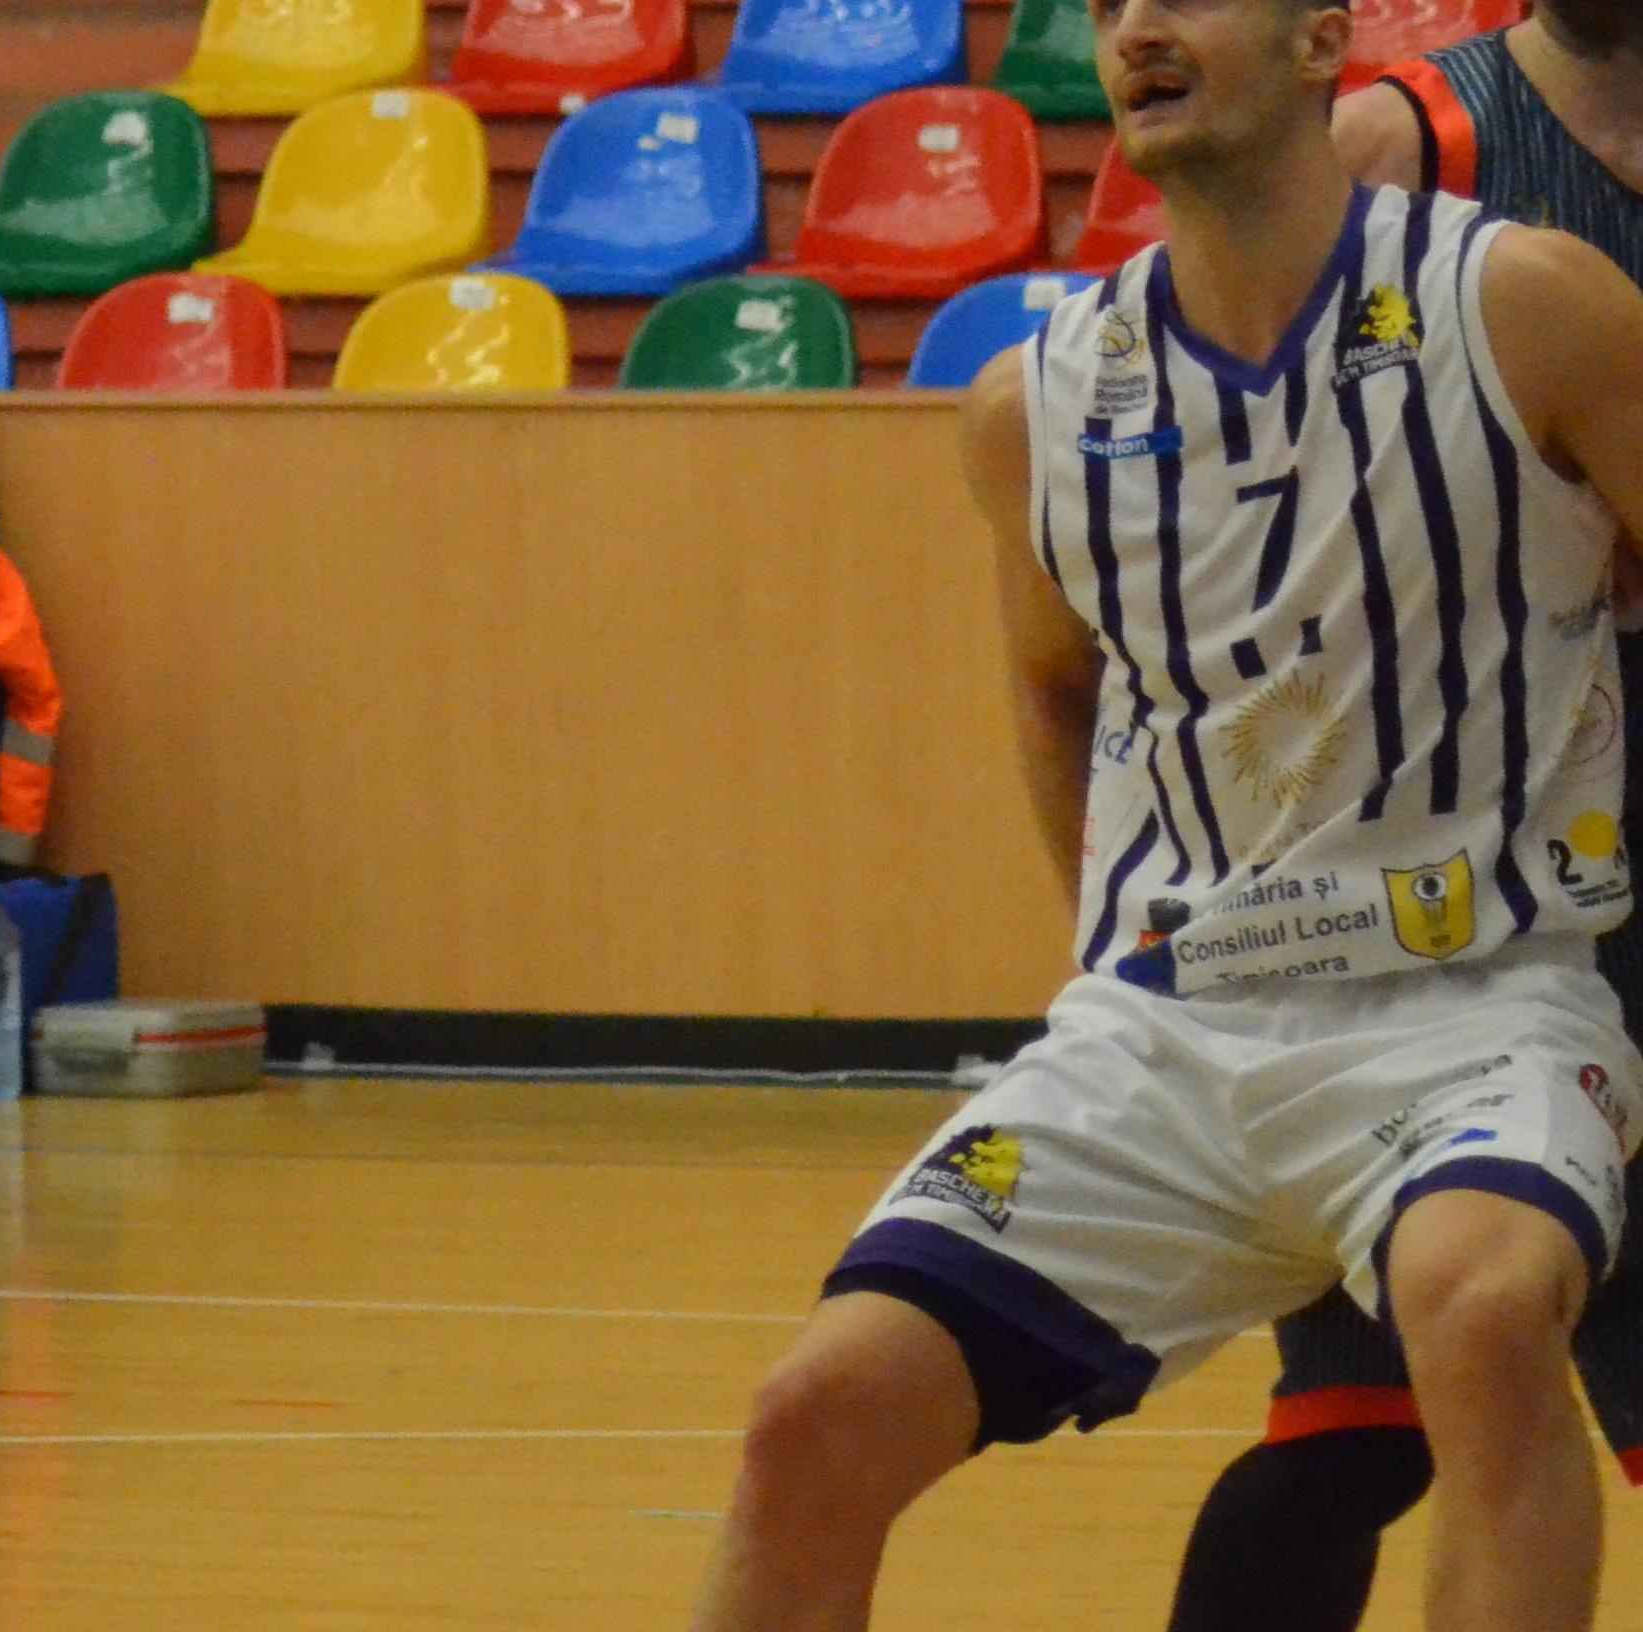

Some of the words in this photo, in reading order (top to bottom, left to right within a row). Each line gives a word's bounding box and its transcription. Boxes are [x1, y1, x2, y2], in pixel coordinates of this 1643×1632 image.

[1078, 437, 1149, 458] cotton
[1234, 464, 1300, 613] 7
[1176, 919, 1287, 965] Consiliul
[1294, 902, 1380, 941] Local
